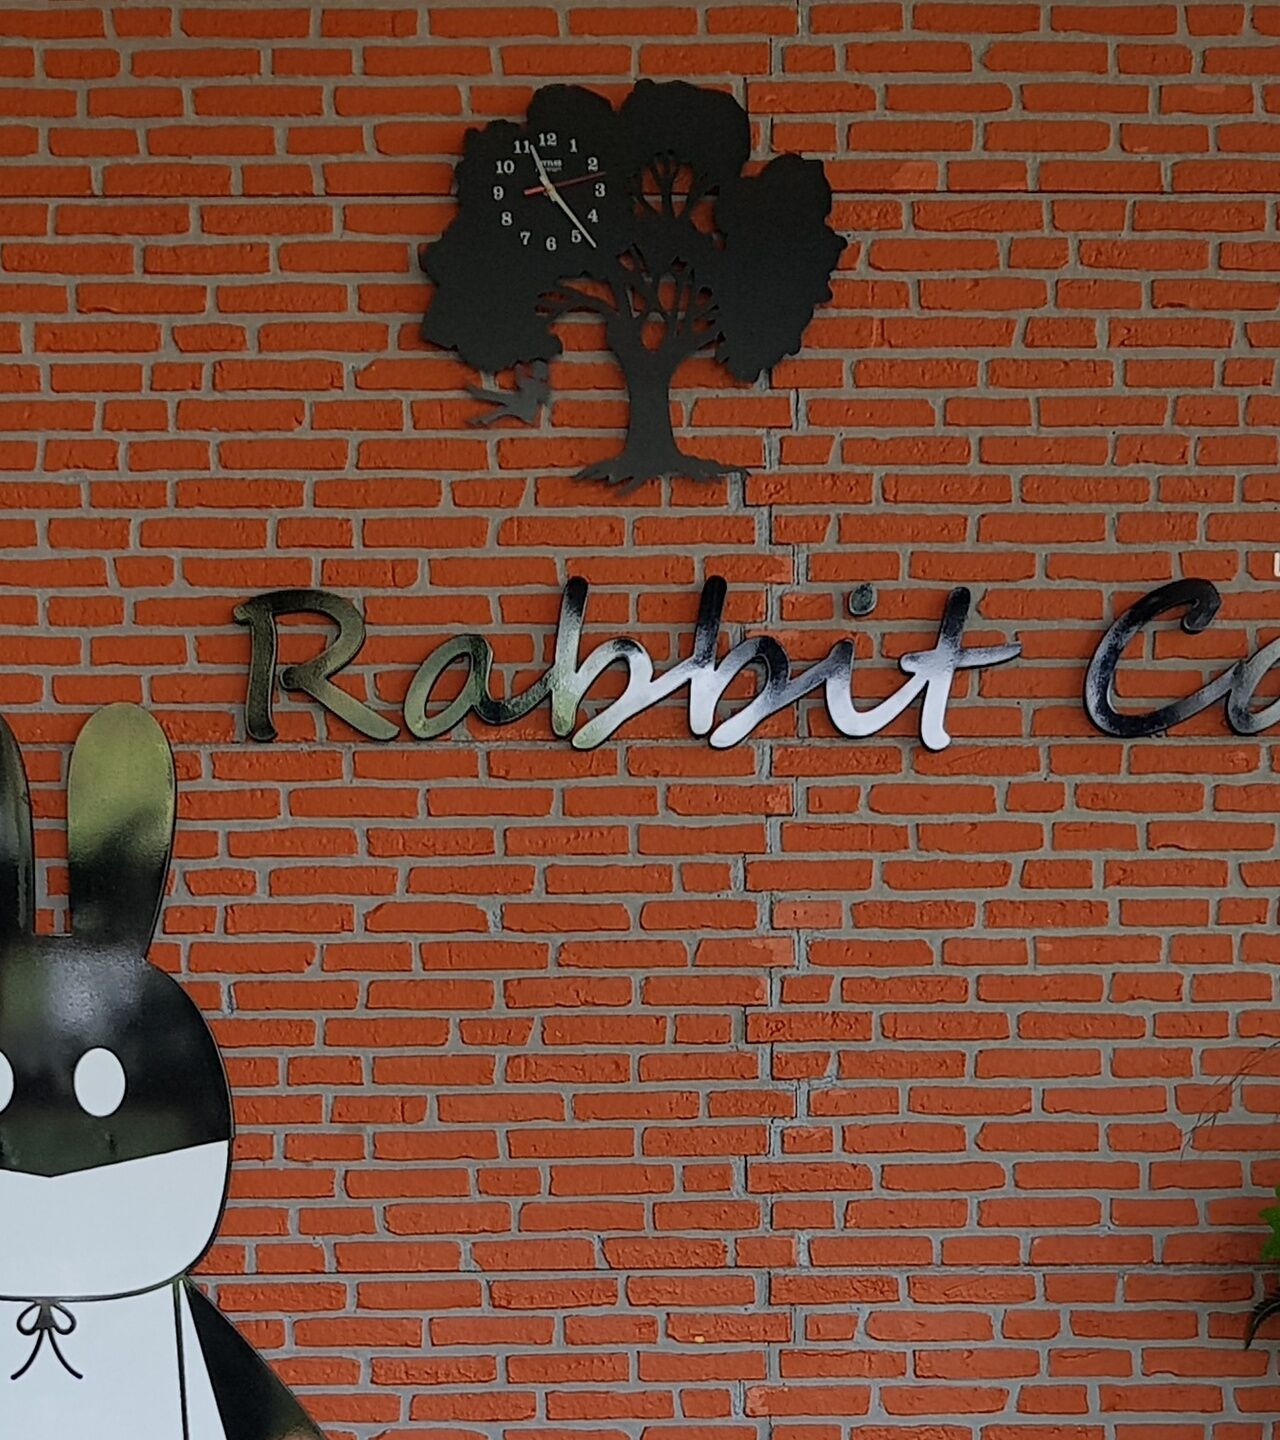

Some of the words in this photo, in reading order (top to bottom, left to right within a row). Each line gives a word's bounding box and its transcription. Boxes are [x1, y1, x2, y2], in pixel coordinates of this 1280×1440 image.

[513, 139, 530, 154] 11
[539, 132, 557, 147] 12
[570, 138, 578, 153] 1
[496, 160, 515, 174] 10
[587, 156, 599, 171] 2
[492, 185, 504, 200] 9
[594, 182, 606, 198] 3
[501, 211, 513, 226] 8
[587, 208, 599, 223] 4
[520, 231, 531, 246] 7
[545, 236, 557, 251] 6
[571, 229, 582, 243] 5
[233, 575, 1022, 752] Rabbit
